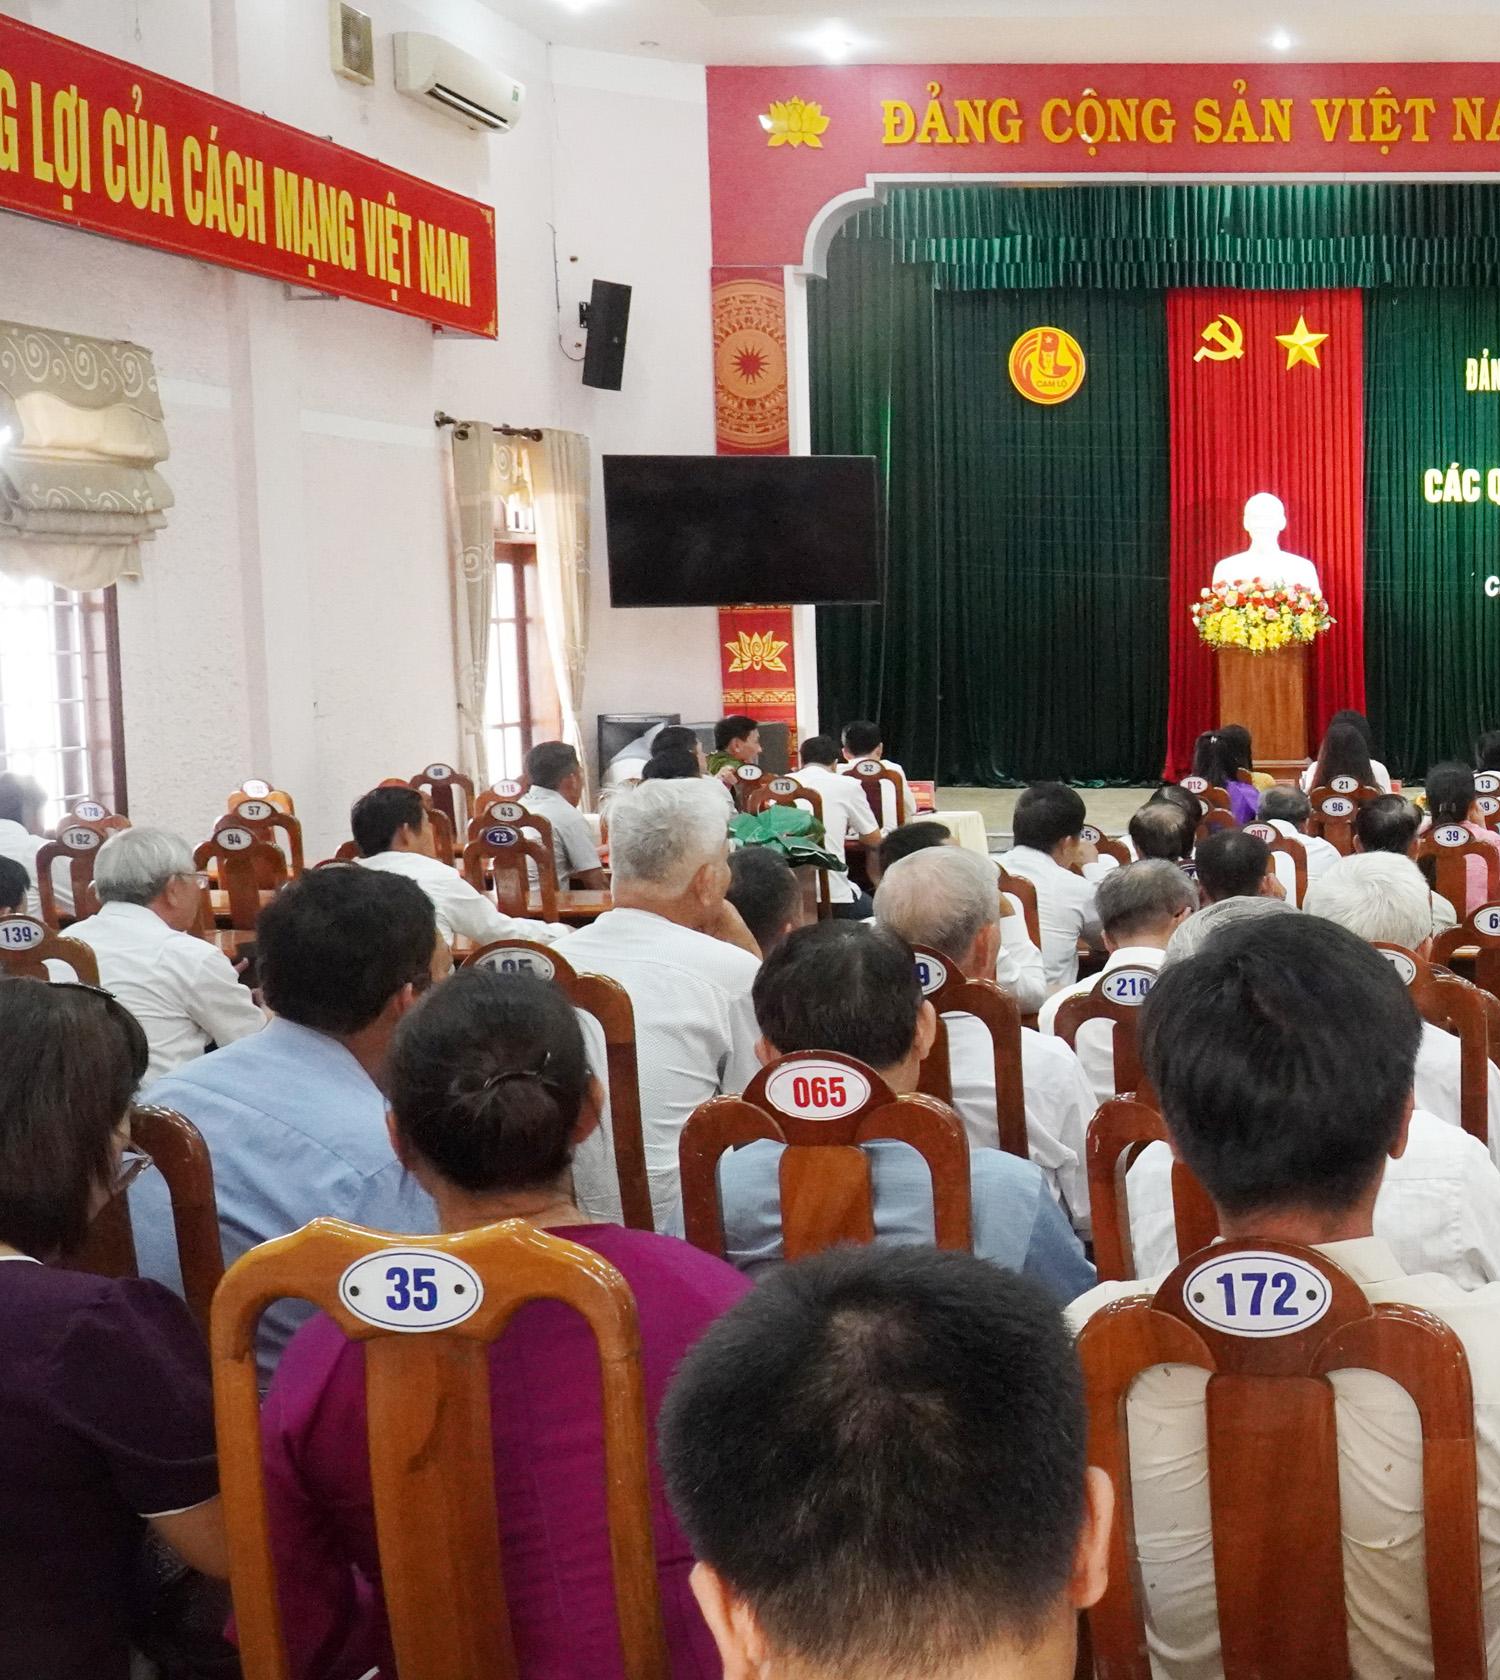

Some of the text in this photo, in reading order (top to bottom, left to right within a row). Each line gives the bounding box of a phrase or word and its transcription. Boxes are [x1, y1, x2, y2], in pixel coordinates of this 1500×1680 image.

[881, 81, 1023, 145] ĐẢNG
[1041, 88, 1176, 157] CỘNG
[1194, 79, 1293, 145] SẢN
[1311, 87, 1436, 155] VIỆT
[31, 82, 91, 210] LỢI
[103, 83, 174, 219] CỦA
[183, 125, 266, 245] CÁCH
[273, 167, 356, 278] MẠNG
[360, 191, 412, 301] VIỆT
[418, 220, 471, 307] NAM
[1424, 462, 1480, 503] CÁC
[1339, 781, 1348, 789] 21
[1481, 781, 1490, 789] 13
[248, 806, 260, 816] 57
[1332, 802, 1343, 811] 96
[502, 808, 514, 817] 43
[228, 834, 241, 844] 94
[494, 832, 507, 842] 72
[1446, 831, 1458, 841] 39
[2, 926, 32, 943] 139
[792, 1076, 848, 1107] 065
[385, 1267, 438, 1311] 35
[1216, 1272, 1300, 1316] 172
